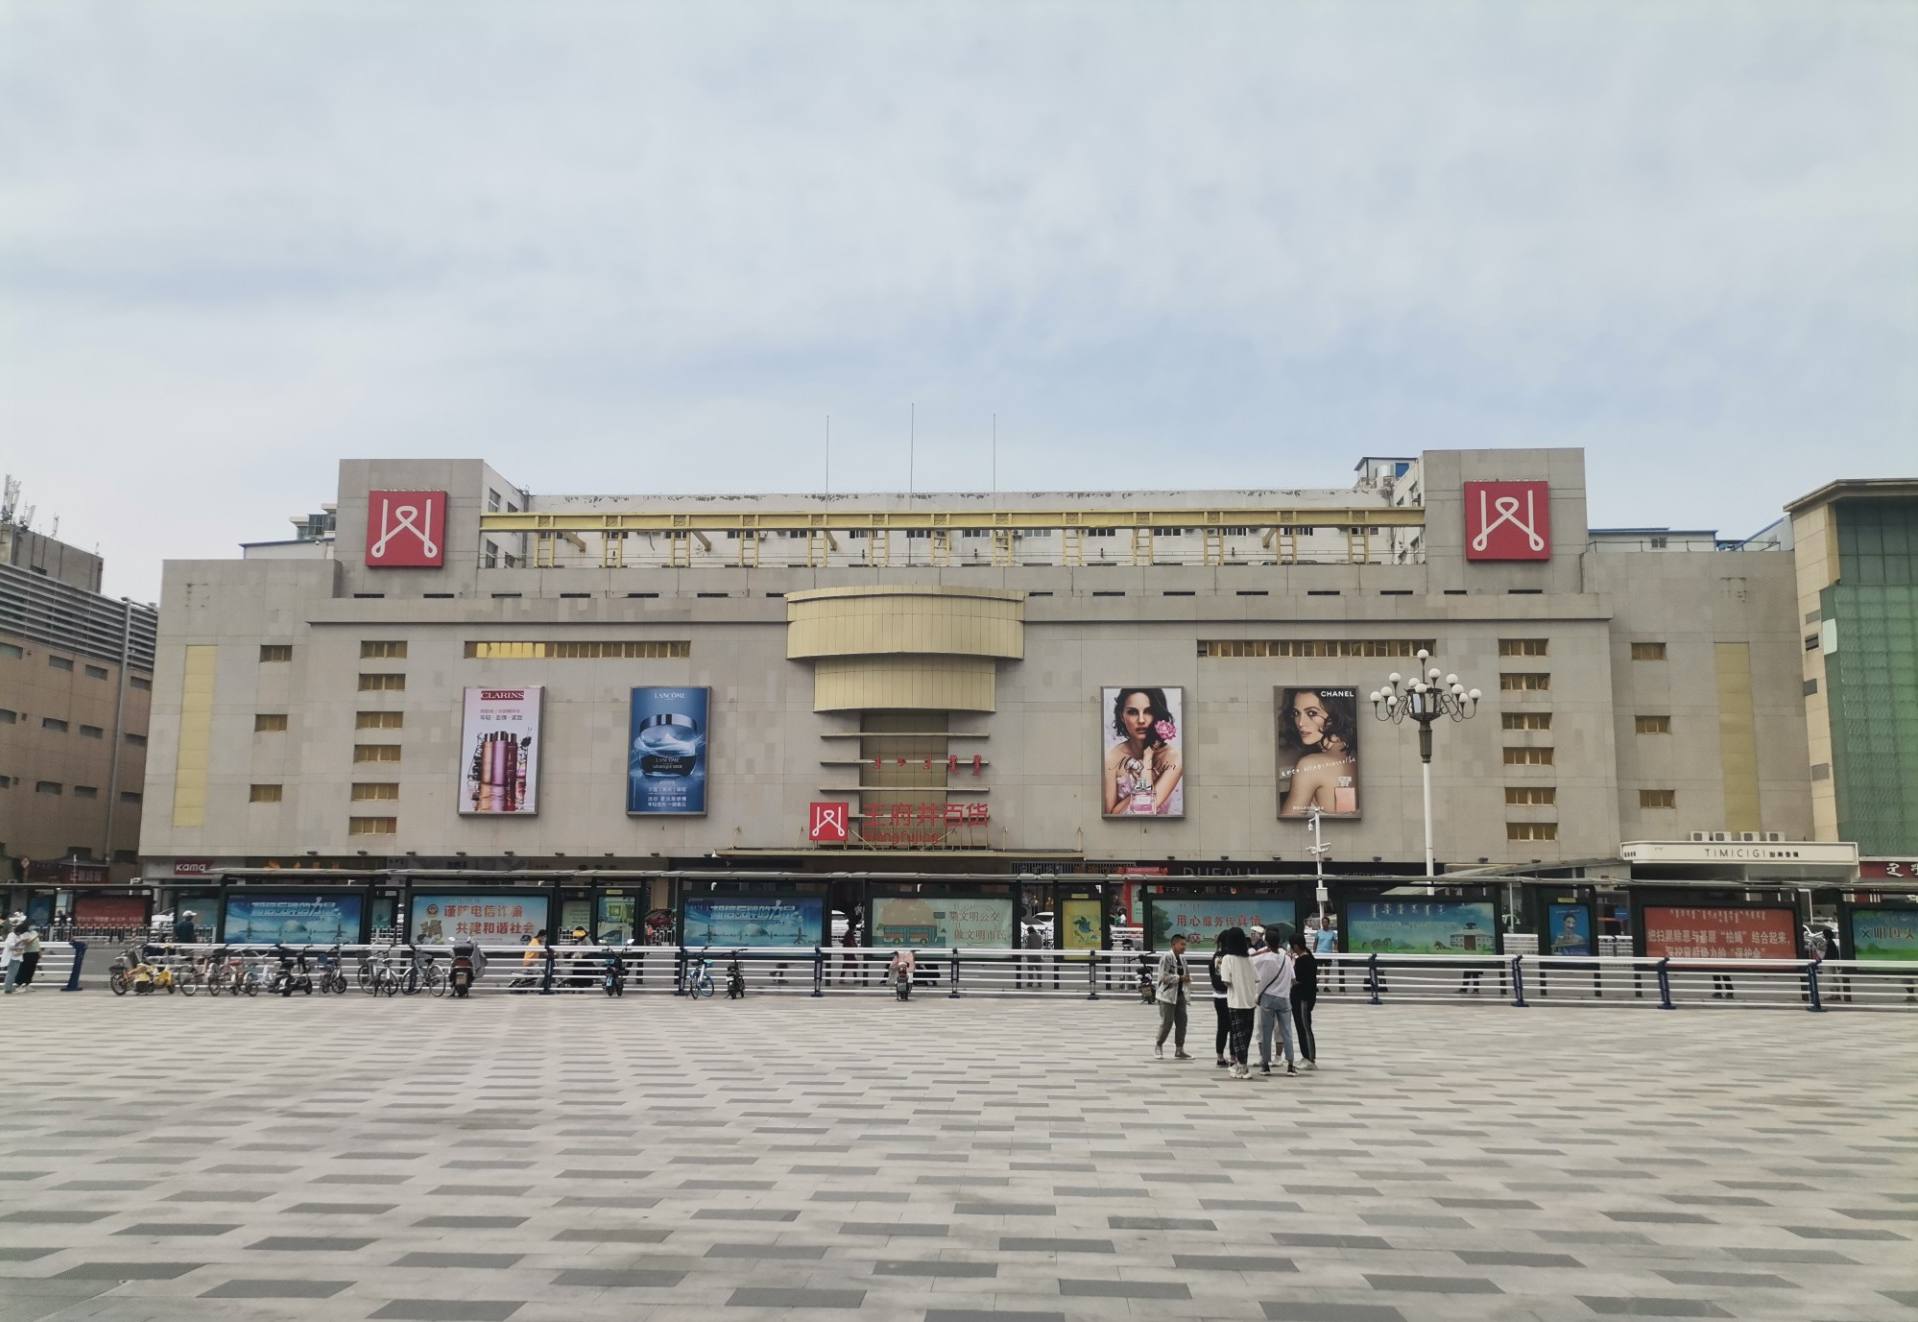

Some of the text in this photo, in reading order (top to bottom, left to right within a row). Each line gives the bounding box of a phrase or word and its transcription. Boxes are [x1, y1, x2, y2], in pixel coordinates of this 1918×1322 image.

[481, 691, 524, 699] CLARINS
[1320, 690, 1355, 698] CHANEL
[862, 801, 989, 827] 王府井百货
[1704, 847, 1766, 859] TIMICIGI
[456, 921, 536, 935] 共建和谐社会
